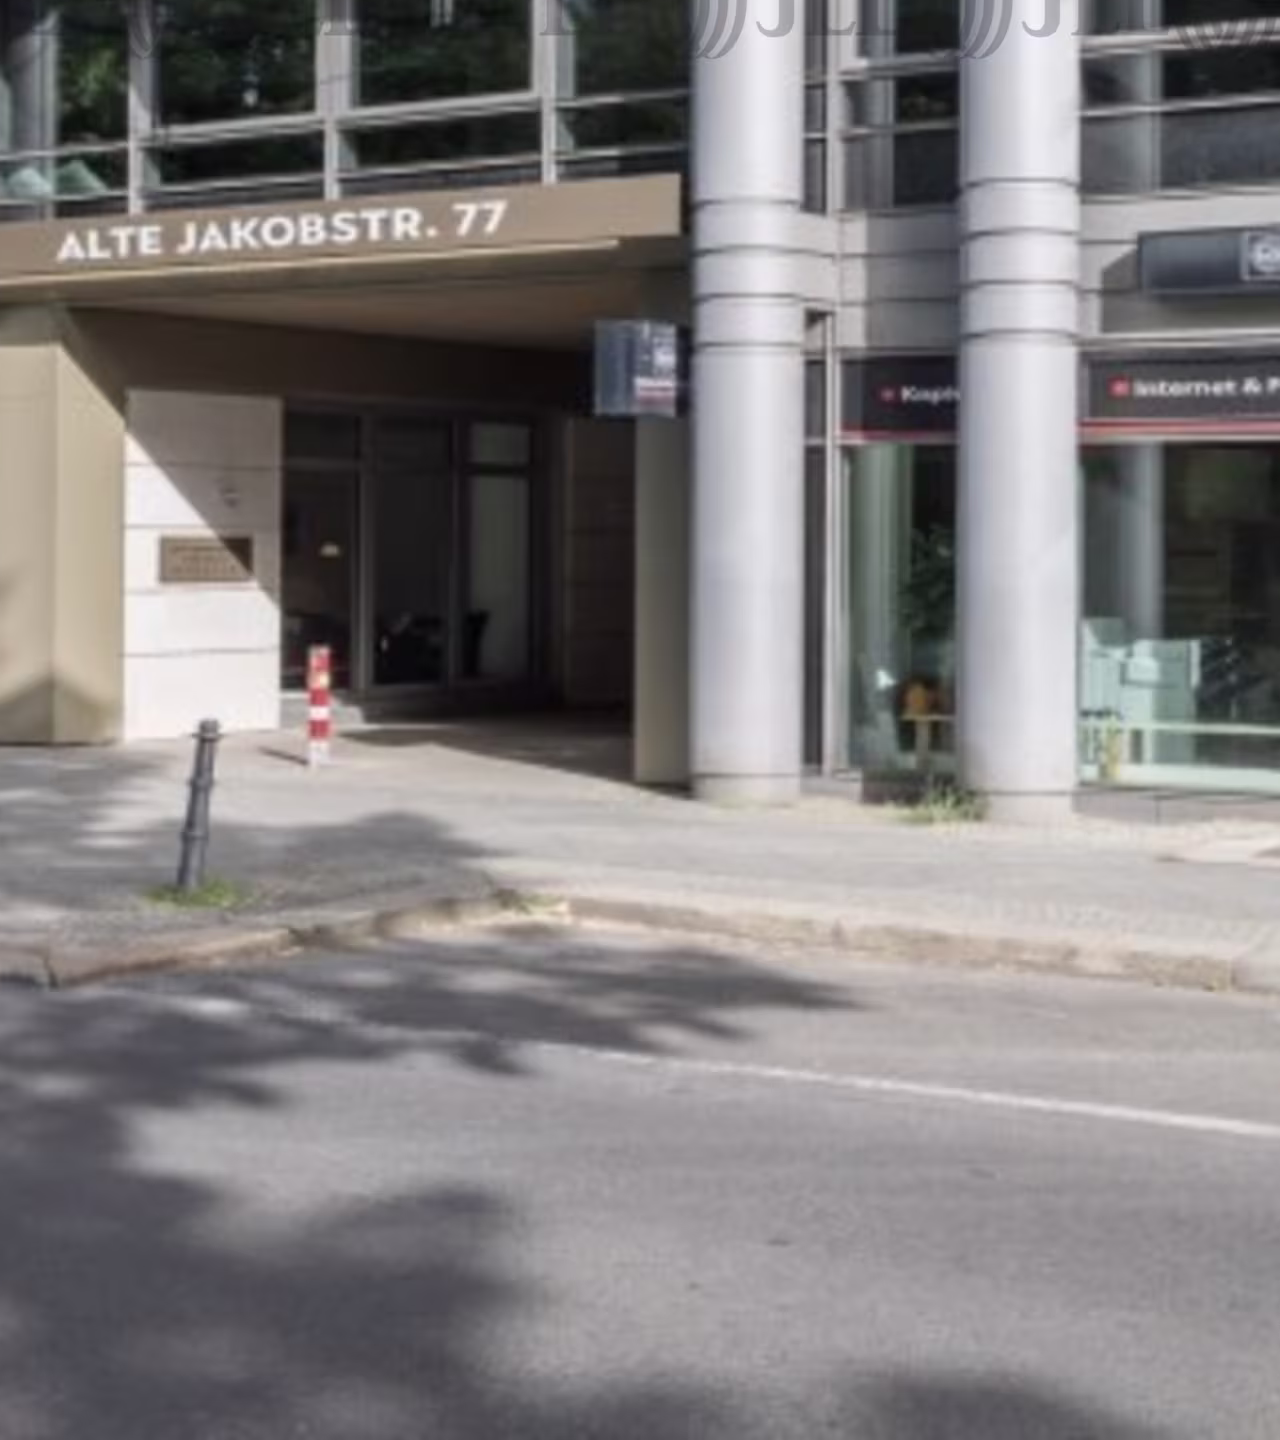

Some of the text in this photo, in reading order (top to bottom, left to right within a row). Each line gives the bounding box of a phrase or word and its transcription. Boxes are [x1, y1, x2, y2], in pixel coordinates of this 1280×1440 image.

[55, 199, 510, 261] ALTE JAKOBSTR. 77
[1133, 374, 1237, 398] Internet
[1241, 375, 1264, 395] &
